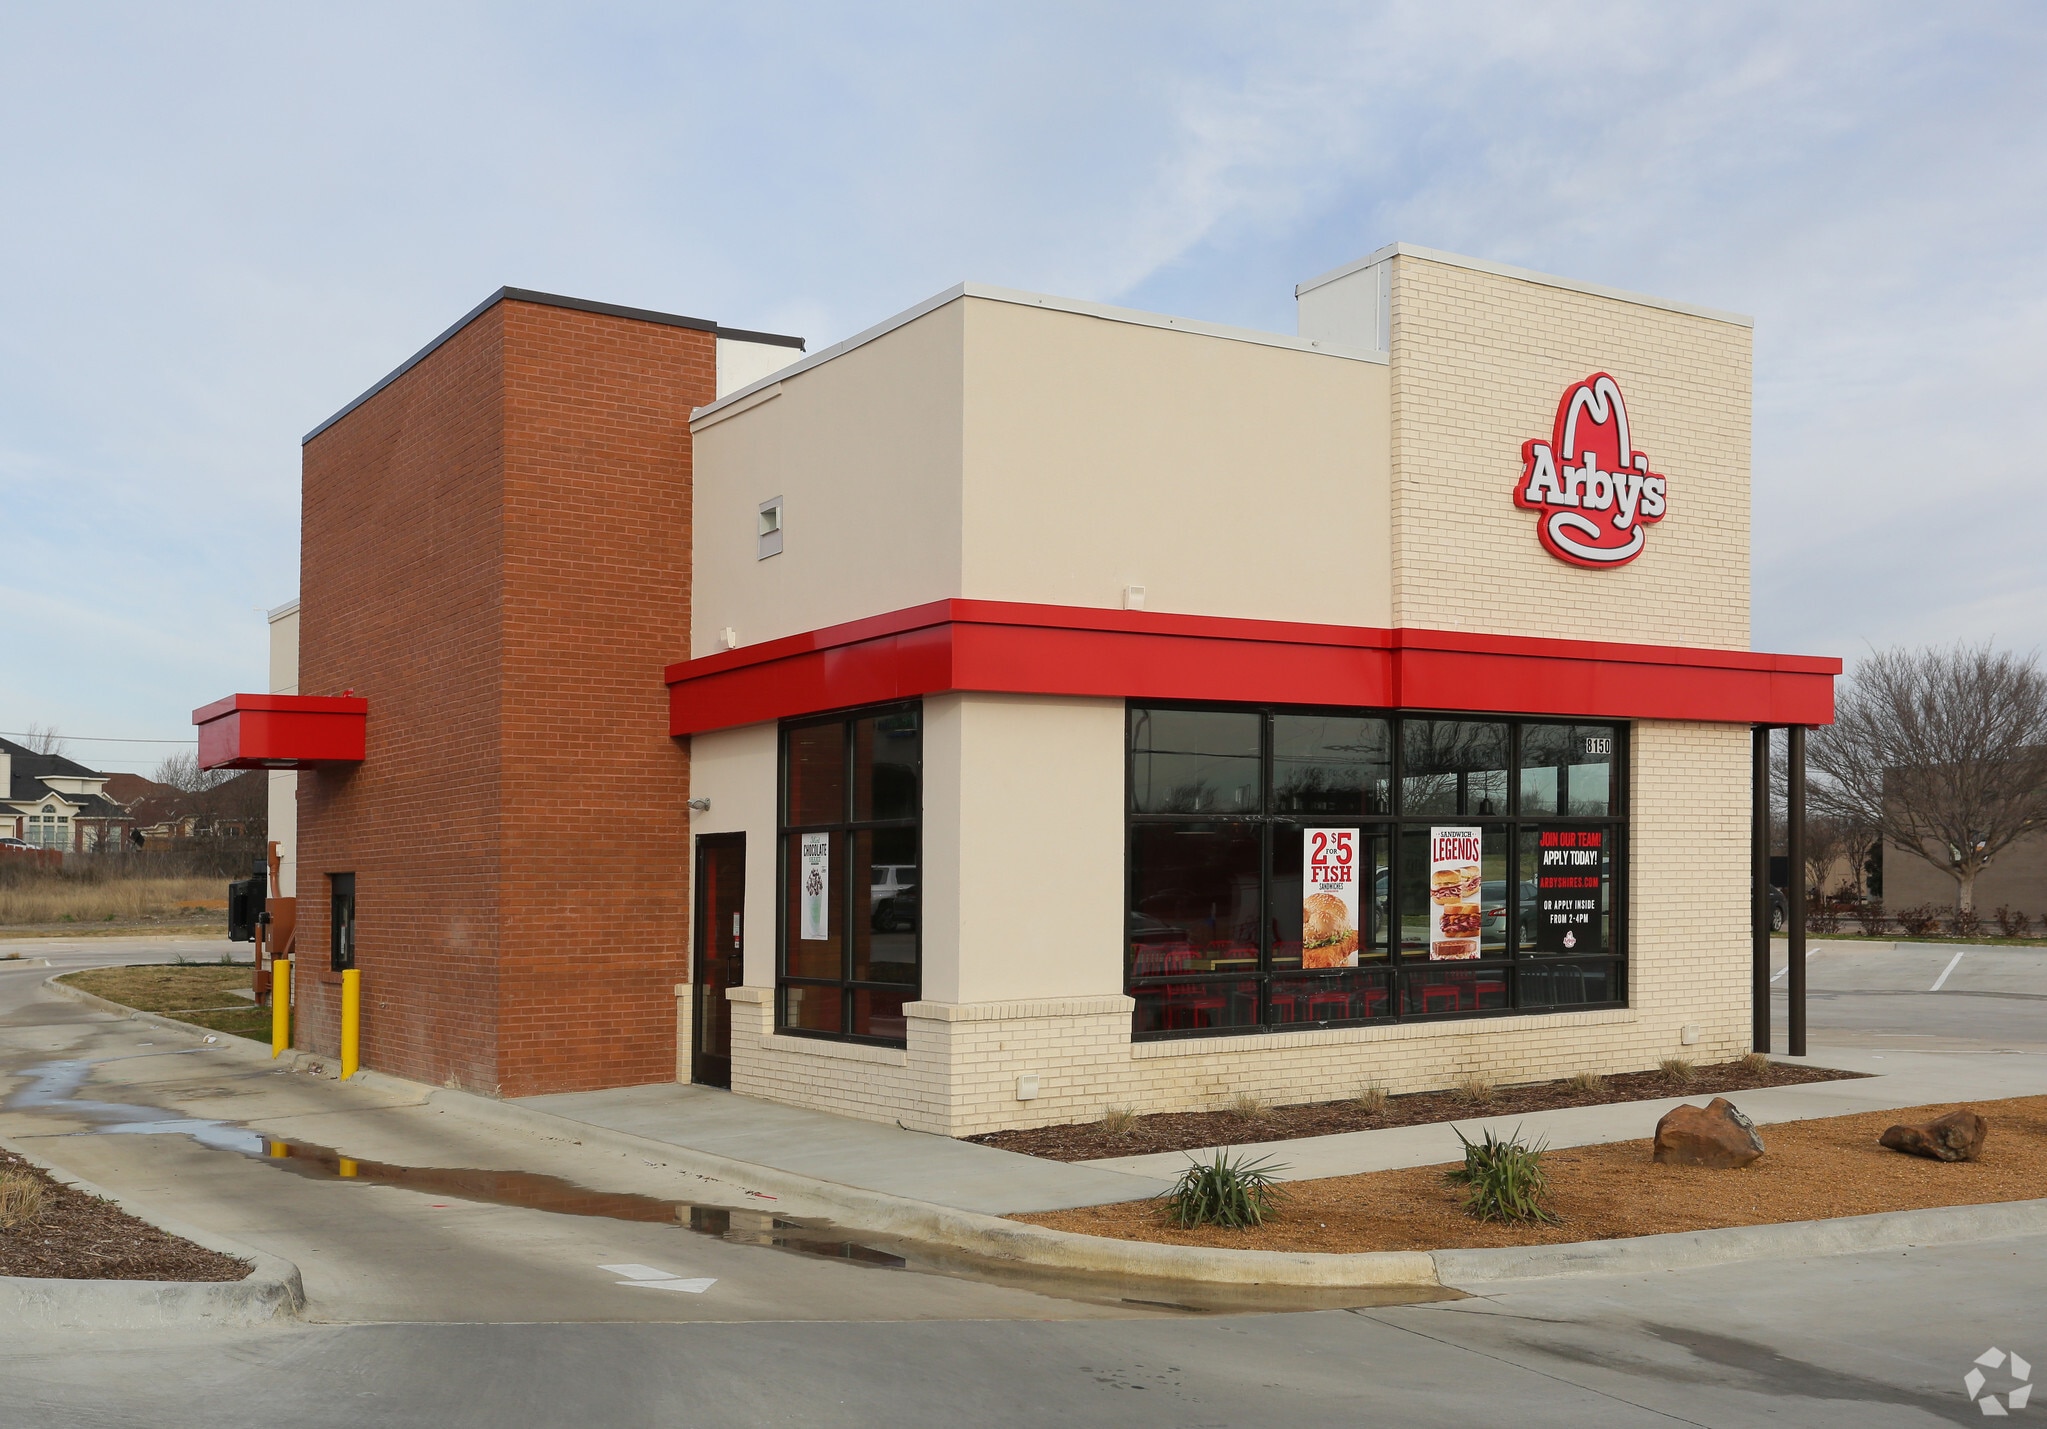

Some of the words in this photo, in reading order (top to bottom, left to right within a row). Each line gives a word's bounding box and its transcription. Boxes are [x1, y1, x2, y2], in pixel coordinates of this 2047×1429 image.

[1525, 443, 1665, 529] Arby's
[1587, 739, 1609, 753] 8150
[1540, 832, 1558, 847] JOIN
[1560, 832, 1576, 847] OUR
[1578, 832, 1602, 847] TEAM!
[804, 844, 826, 856] CHOCOLATE
[1311, 832, 1327, 865] 2
[1433, 838, 1479, 862] LEGENDS
[1543, 850, 1569, 866] APPLY
[1570, 850, 1598, 866] TODAY!
[1311, 866, 1352, 883] FISH
[1540, 877, 1599, 889] ARBYSHIRES.COM
[1543, 900, 1553, 910] OR
[1553, 900, 1573, 910] APPLY
[1574, 900, 1595, 910] INSIDE
[1550, 914, 1567, 924] FROM
[1568, 913, 1589, 924] 2-4PM
